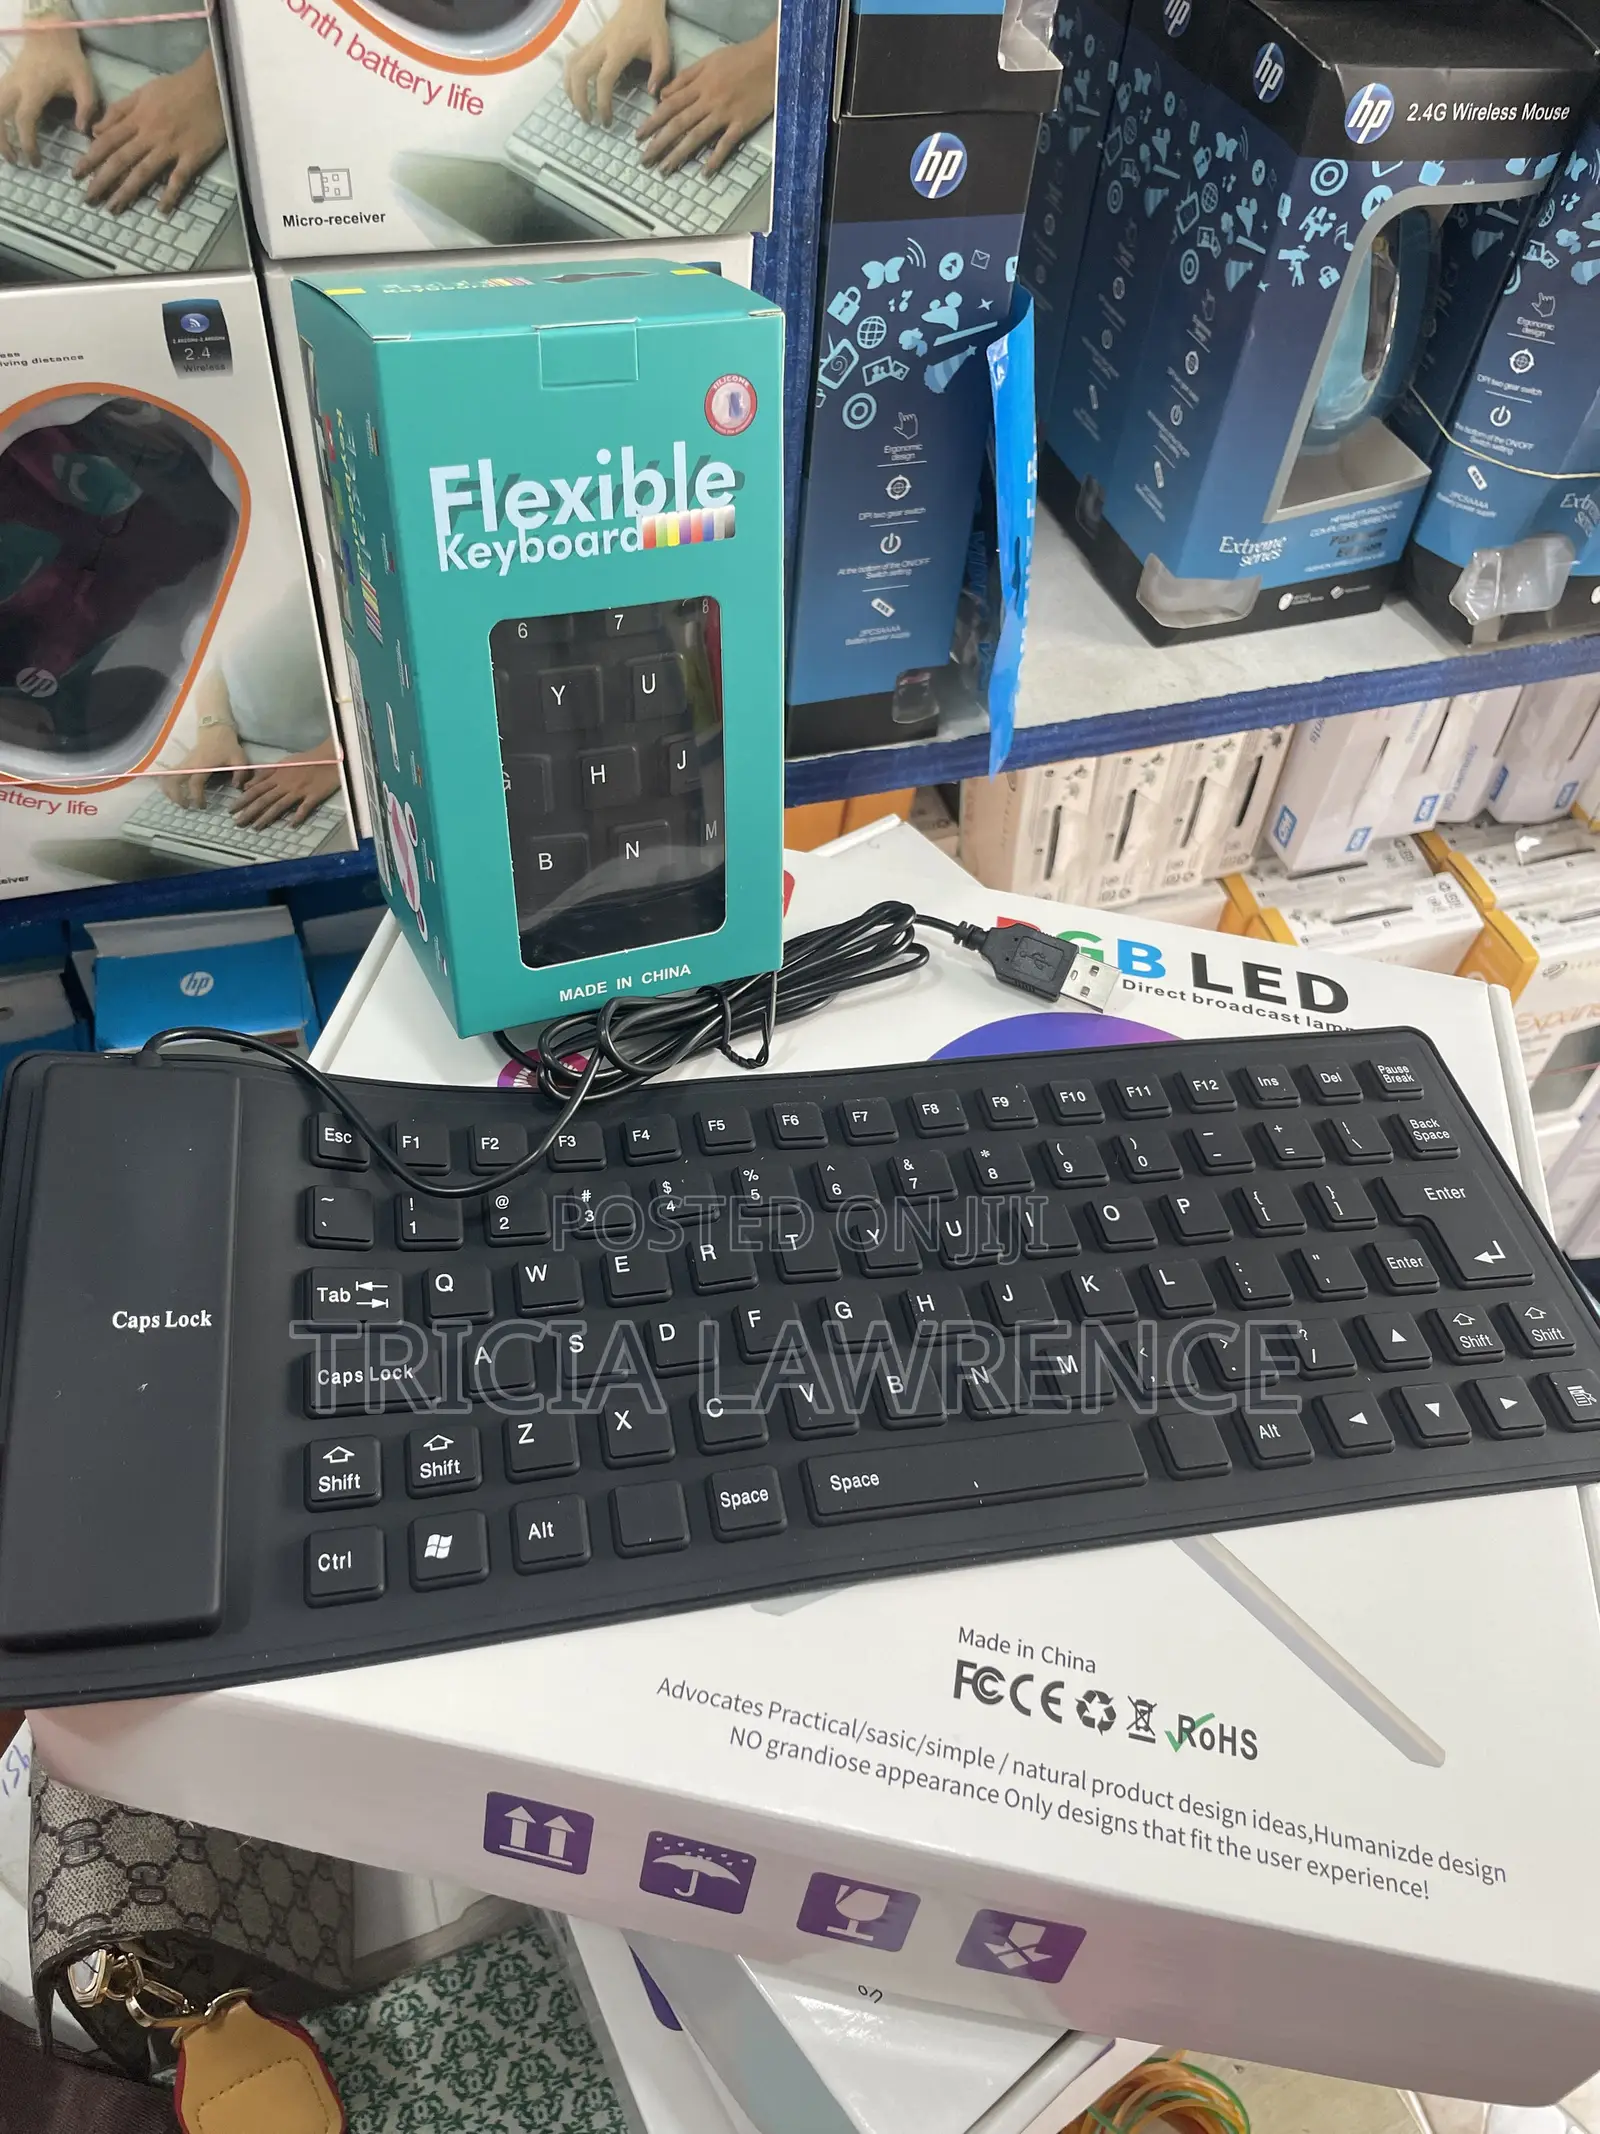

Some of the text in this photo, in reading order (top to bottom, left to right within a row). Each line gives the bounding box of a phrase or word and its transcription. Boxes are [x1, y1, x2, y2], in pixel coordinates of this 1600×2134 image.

[346, 34, 443, 105] battery
[447, 83, 484, 116] life
[1255, 42, 1283, 101] hp
[1349, 83, 1570, 144] hp 2.4G Wireless Mouse
[917, 132, 961, 198] hp
[282, 212, 386, 227] Micro-receiver
[31, 355, 84, 365] distance
[184, 347, 211, 360] 2.4
[183, 364, 226, 373] Wireless
[429, 441, 736, 537] Flexible
[437, 517, 643, 576] Keyboard
[1219, 536, 1288, 554] Extreme
[517, 622, 528, 639] 6
[614, 614, 624, 630] 7
[550, 672, 656, 706] Y U
[590, 749, 686, 785] H J
[66, 800, 98, 815] life
[538, 820, 719, 871] B N M
[997, 916, 1349, 1014] GB LED
[182, 971, 212, 996] hp
[559, 964, 692, 1002] MADE IN CHINA
[1122, 978, 1187, 1001] Direct
[1192, 986, 1300, 1025] broadcast
[1320, 1071, 1343, 1084] Del
[1377, 1064, 1411, 1075] Pause
[1382, 1073, 1415, 1084] Break
[1192, 1079, 1220, 1092] F12
[1257, 1076, 1280, 1087] Ins
[1059, 1091, 1086, 1103] F10
[1126, 1085, 1152, 1098] F11
[921, 1103, 940, 1115] F8
[991, 1096, 1010, 1108] F9
[707, 1119, 726, 1132] F5
[781, 1114, 800, 1126] F6
[852, 1110, 868, 1123] F7
[1407, 1116, 1442, 1130] Back
[324, 1127, 352, 1144] Esc
[402, 1135, 420, 1149] F1
[481, 1137, 500, 1150] F2
[558, 1135, 577, 1148] F3
[632, 1129, 651, 1142] F4
[1412, 1128, 1450, 1143] Space
[1063, 1161, 1074, 1173] 9
[1137, 1155, 1148, 1167] 0
[987, 1167, 999, 1180] 8
[831, 1183, 842, 1196] 6
[908, 1177, 918, 1190] 7
[750, 1188, 761, 1201] 5
[1423, 1186, 1466, 1201] Enter
[666, 1200, 676, 1212] 4
[1102, 1205, 1120, 1222] O
[1176, 1198, 1190, 1214] P
[499, 1216, 510, 1230] 2
[584, 1209, 595, 1222] 3
[1025, 1211, 1034, 1228] I
[409, 1220, 416, 1234] 1
[945, 1220, 962, 1237] U
[784, 1233, 799, 1251] T
[866, 1228, 880, 1245] Y
[699, 1243, 717, 1262] R
[614, 1255, 631, 1273] E
[1386, 1256, 1424, 1270] Enter
[525, 1263, 548, 1283] W
[1158, 1269, 1176, 1286] L
[435, 1273, 454, 1292] Q
[1080, 1275, 1100, 1293] K
[316, 1287, 351, 1303] Tab
[1002, 1284, 1014, 1302] J
[834, 1301, 853, 1320] G
[916, 1294, 935, 1313] H
[112, 1309, 212, 1333] Caps Lock
[747, 1309, 761, 1328] F
[658, 1323, 676, 1342] D
[1459, 1333, 1494, 1349] Shift
[1531, 1327, 1566, 1342] Shift
[568, 1334, 585, 1354] S
[474, 1346, 493, 1366] A
[1055, 1354, 1079, 1375] M
[317, 1365, 414, 1387] Caps Lock
[886, 1375, 904, 1394] B
[969, 1365, 990, 1386] N
[798, 1383, 814, 1403] V
[706, 1397, 724, 1418] C
[614, 1409, 633, 1431] X
[517, 1422, 535, 1445] Z
[1259, 1423, 1281, 1440] Alt
[420, 1459, 461, 1479] Shift
[318, 1473, 361, 1493] Shift
[829, 1473, 880, 1494] Space
[720, 1489, 769, 1511] Space
[528, 1521, 555, 1541] Alt
[317, 1550, 352, 1572] Ctrl
[958, 1626, 1097, 1674] Made in China
[1177, 1713, 1258, 1761] RoHS
[656, 1677, 764, 1718] Advocates
[768, 1701, 996, 1771] Practical/sasic/simple
[1013, 1757, 1087, 1792] natural
[1092, 1777, 1174, 1811] product
[1178, 1796, 1247, 1829] design
[1252, 1809, 1434, 1869] ideas,Humanizde
[1437, 1850, 1507, 1886] design
[729, 1725, 1430, 1900] NO grandiose appearance Only designs that fit the user experience!
